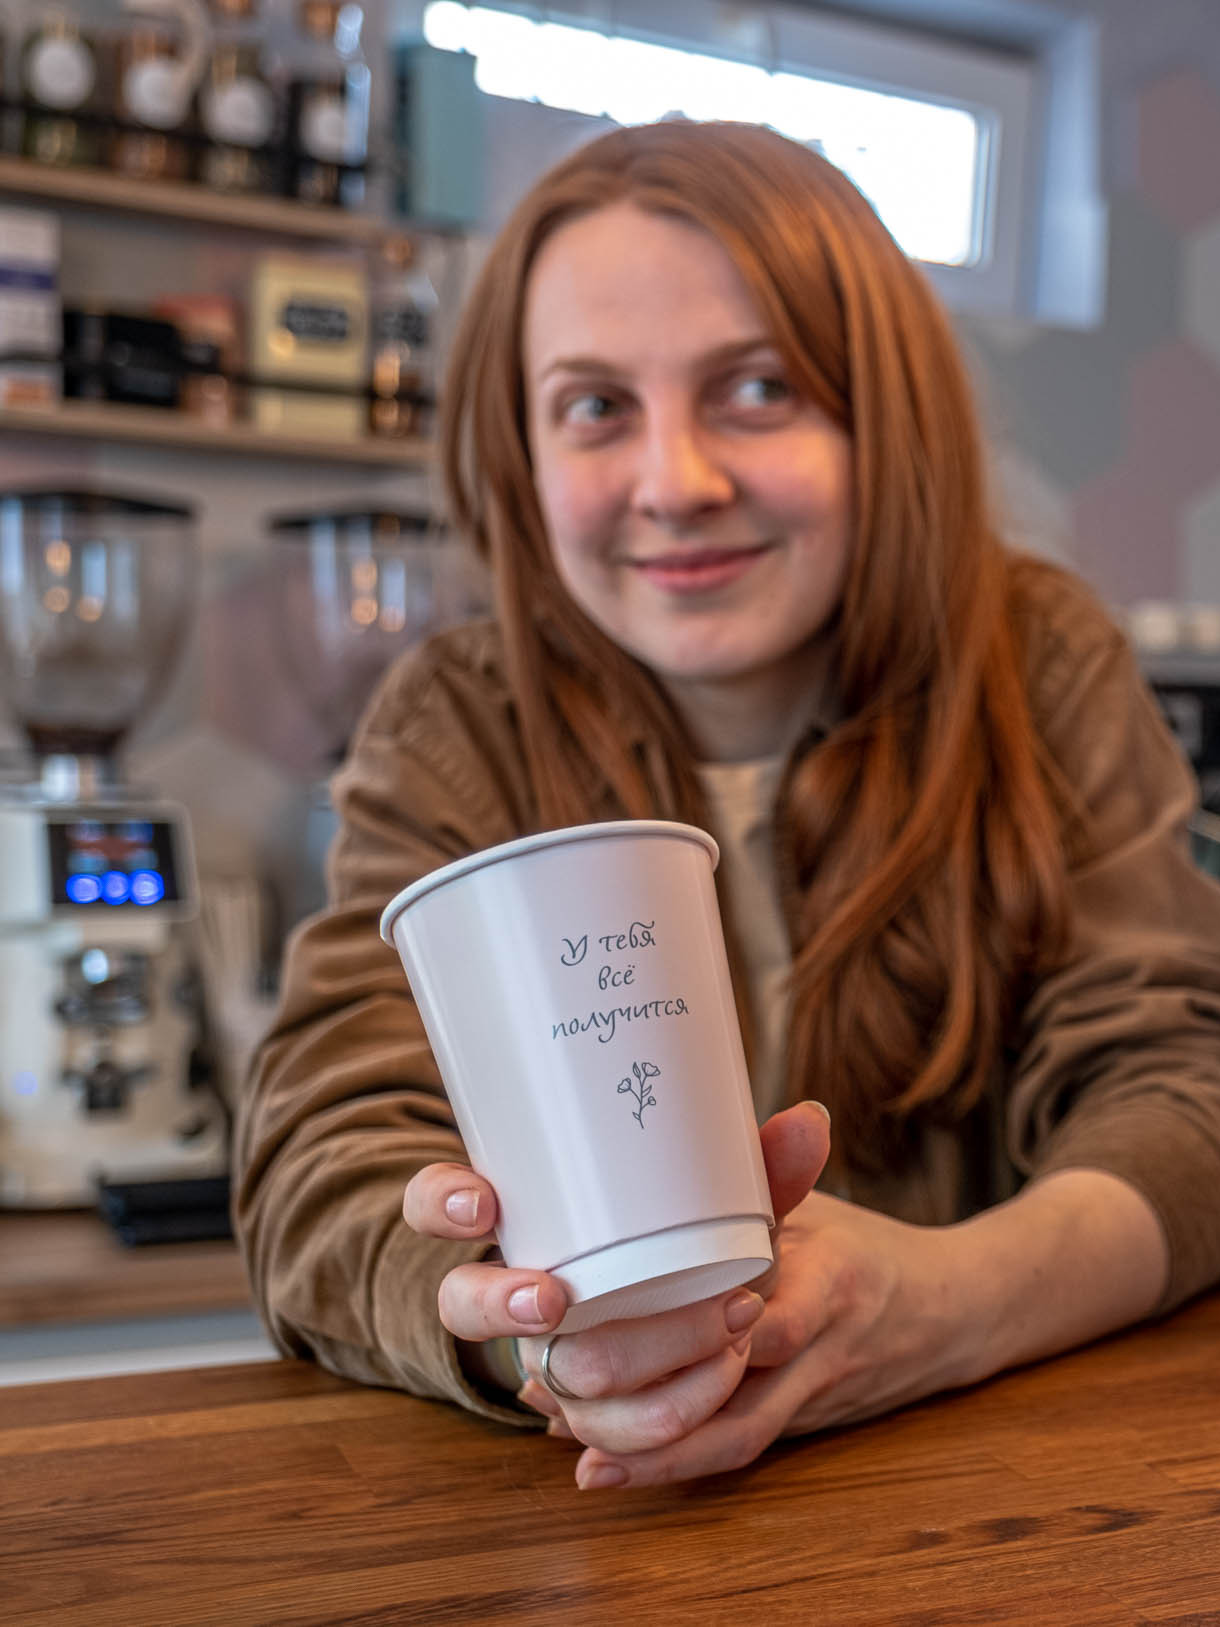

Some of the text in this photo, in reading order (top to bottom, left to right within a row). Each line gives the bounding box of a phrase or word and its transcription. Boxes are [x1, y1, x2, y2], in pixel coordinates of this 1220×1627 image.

[560, 920, 657, 967] У тебя
[597, 964, 637, 991] всё
[551, 997, 690, 1044] получится
